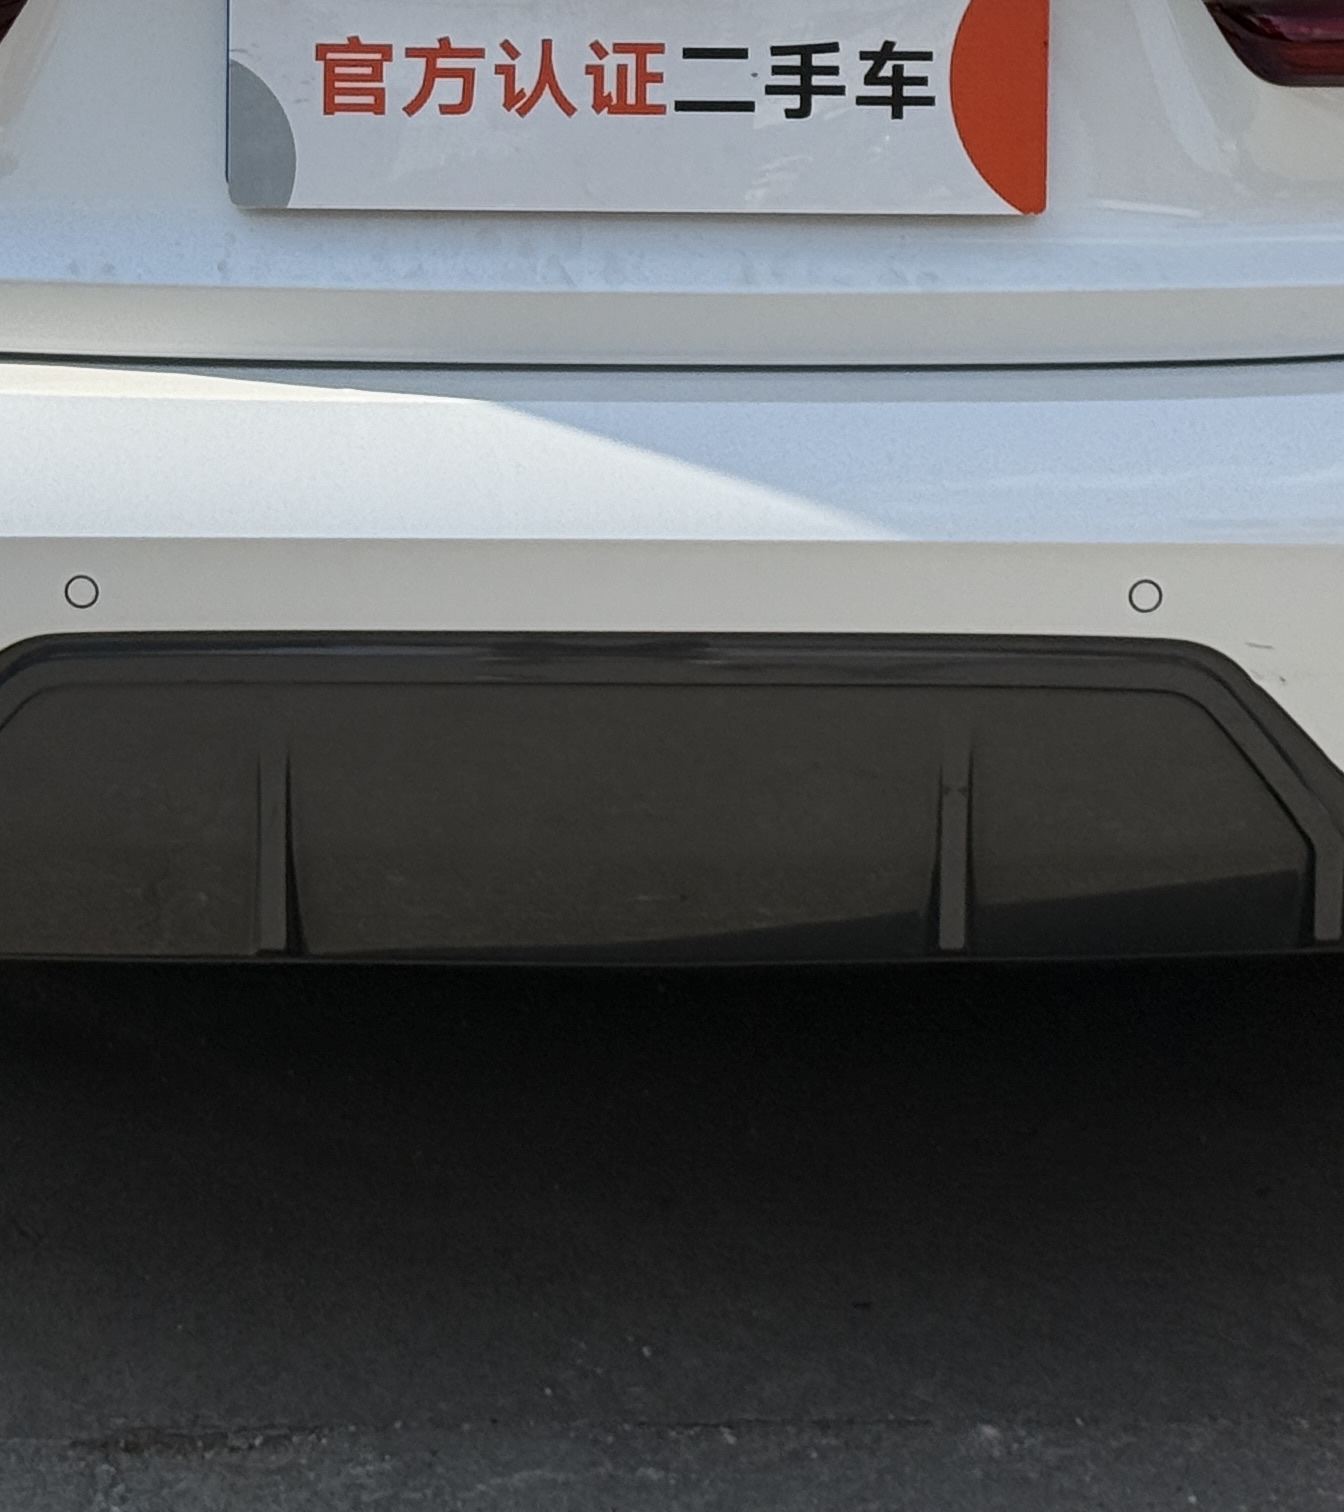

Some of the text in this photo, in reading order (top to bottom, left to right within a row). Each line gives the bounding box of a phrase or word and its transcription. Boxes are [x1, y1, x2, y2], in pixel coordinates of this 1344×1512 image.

[313, 35, 937, 120] 官方认证二手车
